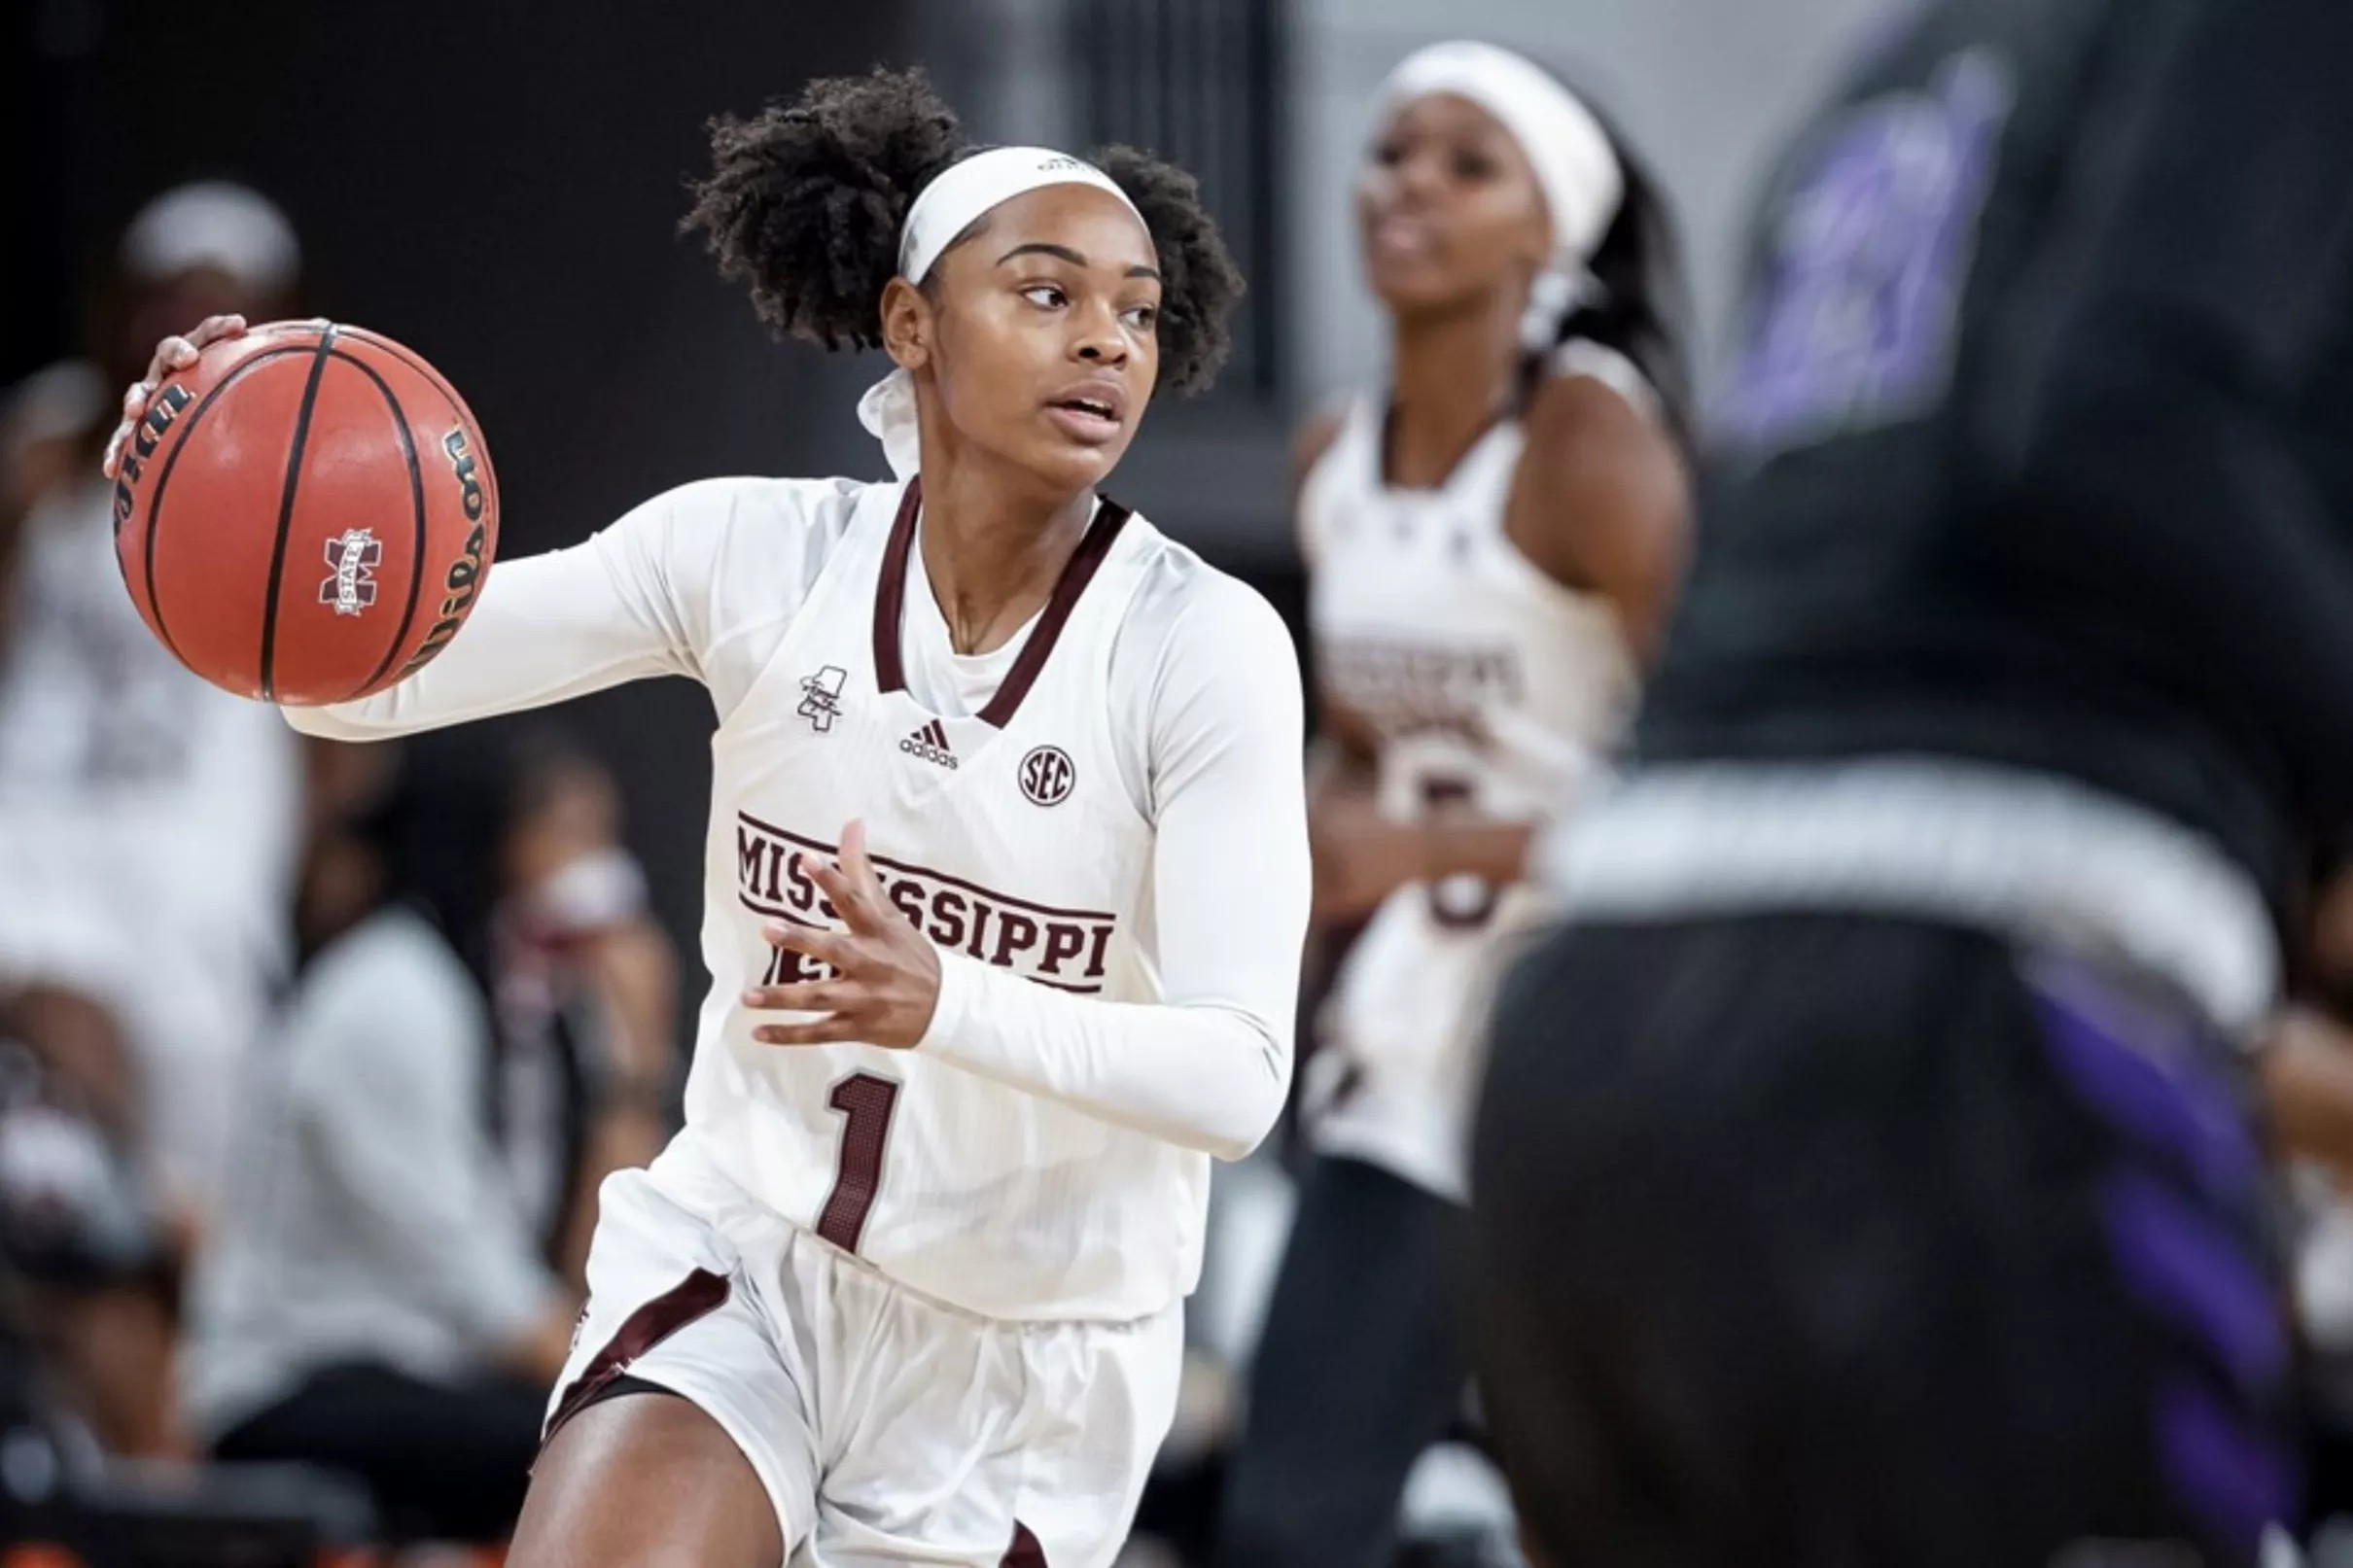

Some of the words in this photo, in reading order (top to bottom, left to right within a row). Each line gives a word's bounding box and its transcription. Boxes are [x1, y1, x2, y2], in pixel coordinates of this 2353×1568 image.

[340, 544, 361, 601] STATE
[899, 738, 959, 771] adidas
[1024, 751, 1070, 800] SEC
[738, 825, 1114, 979] MISSSIPPI
[815, 1070, 900, 1255] 1
